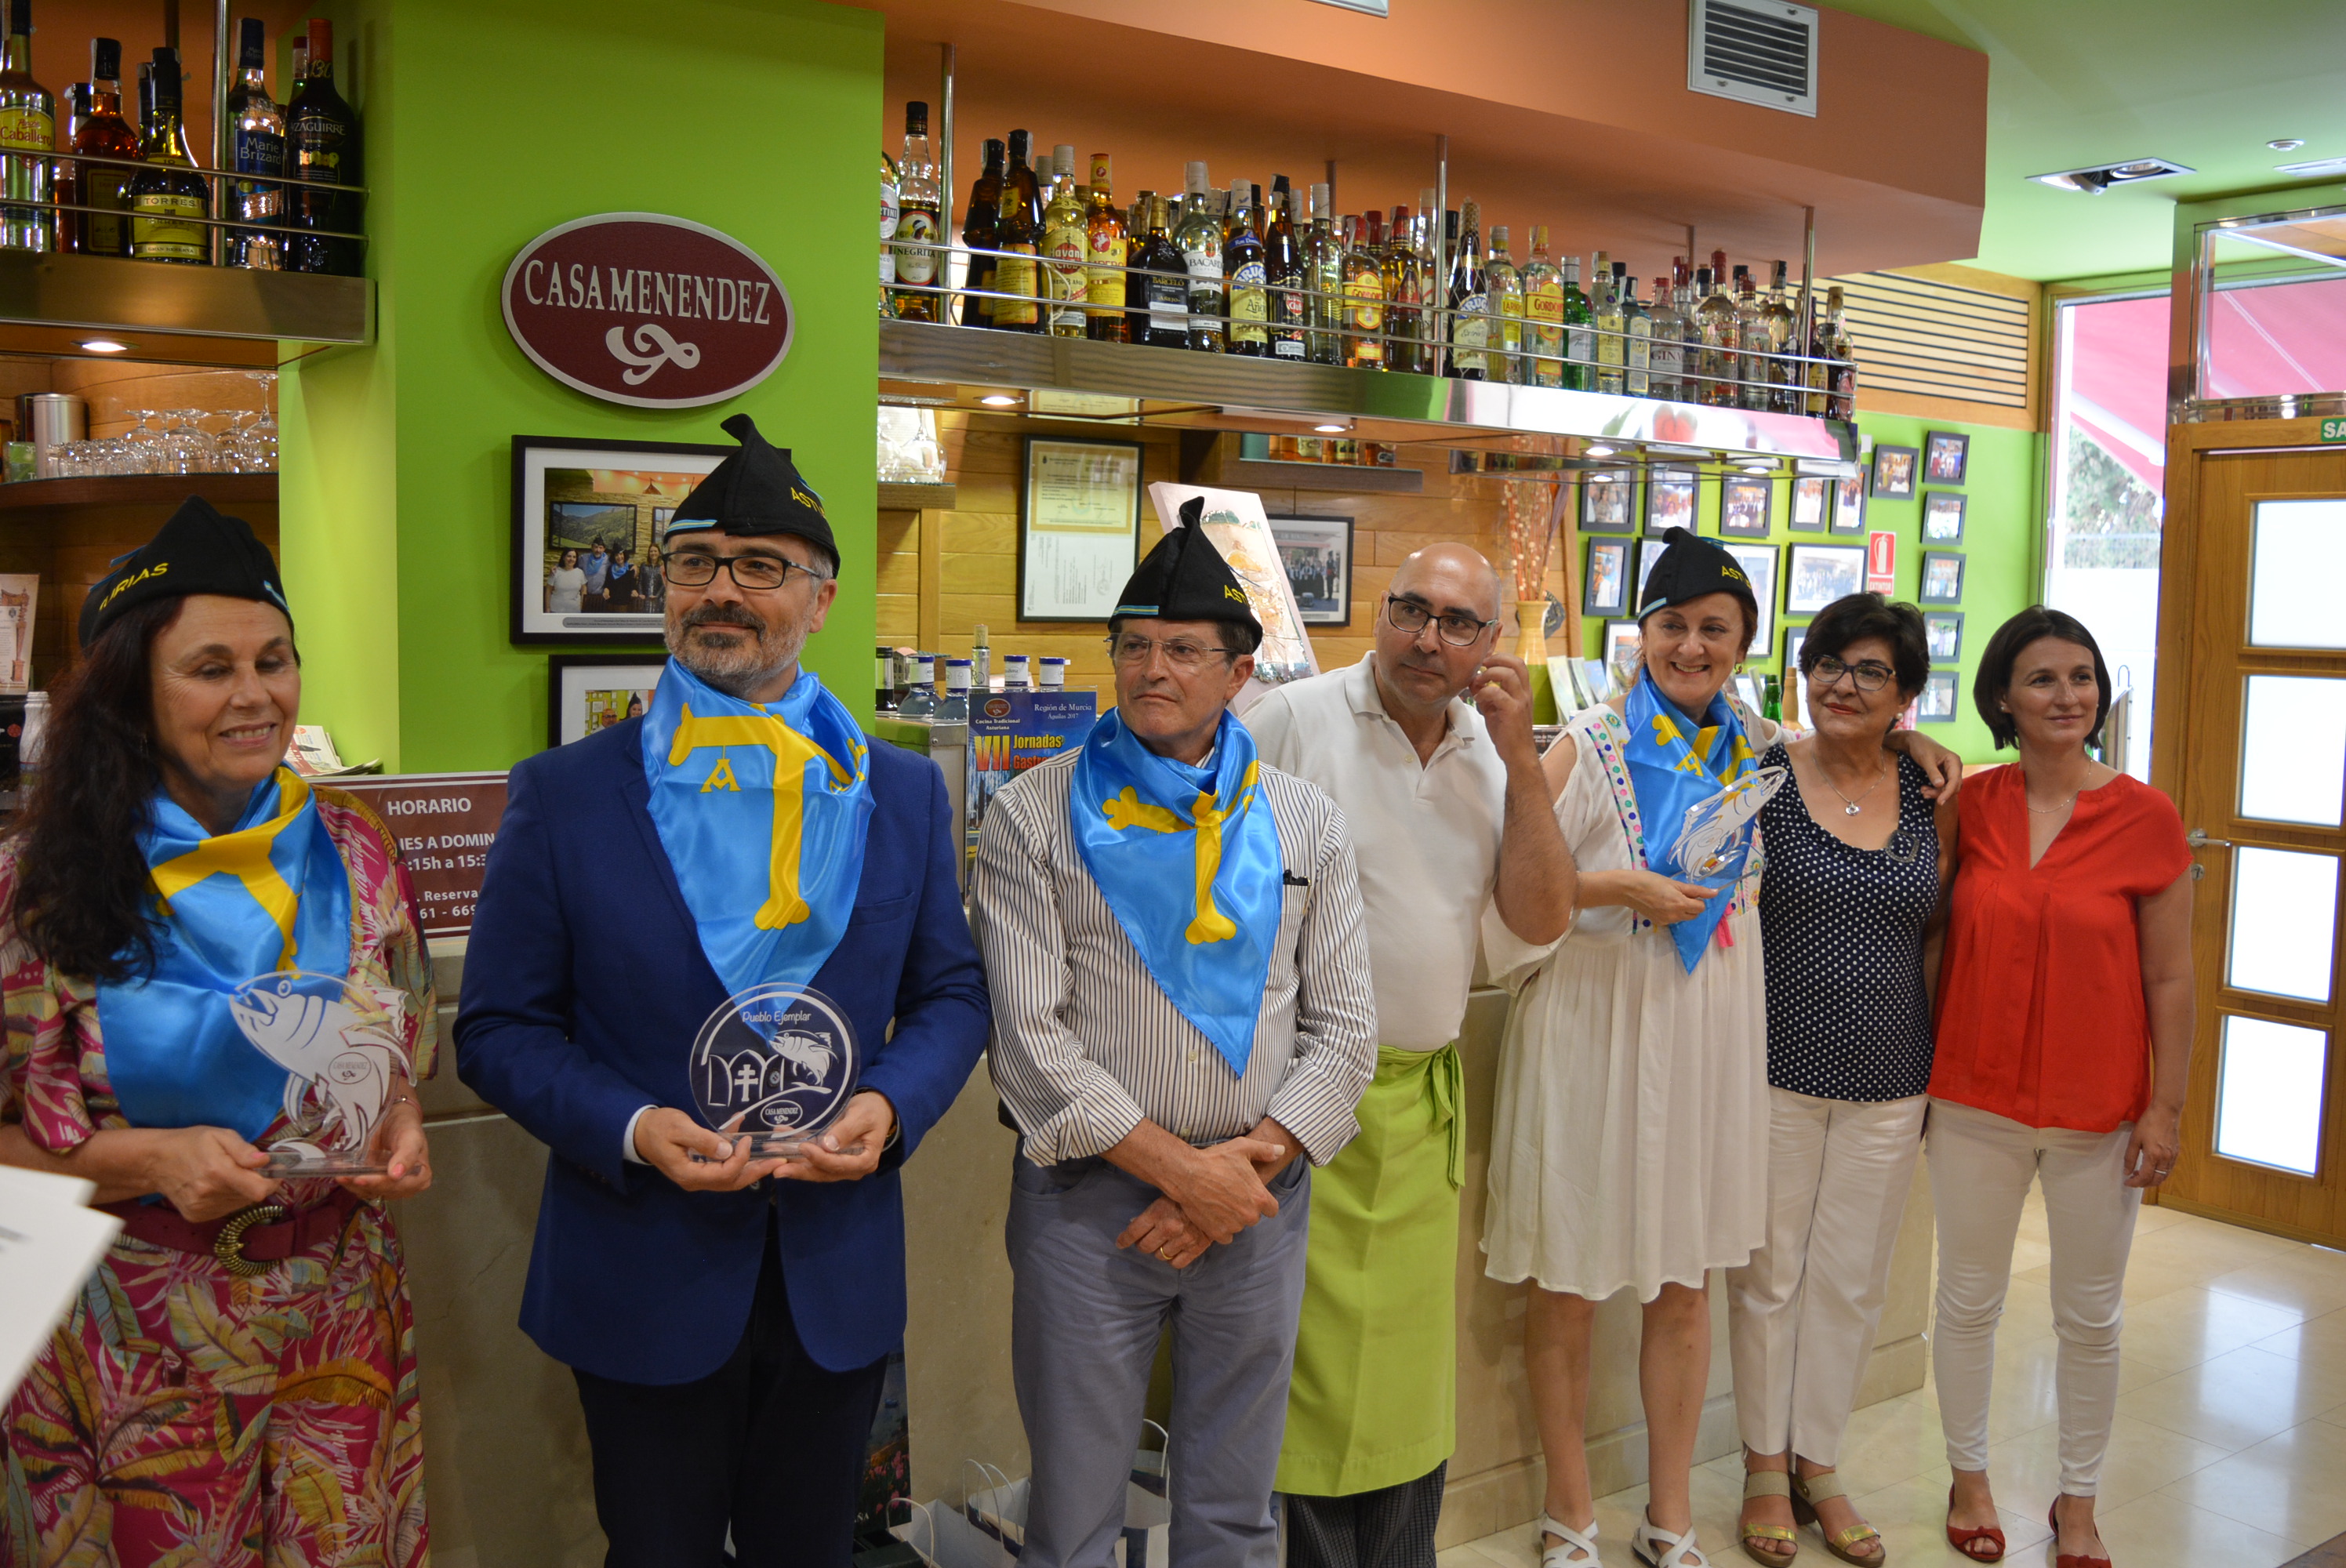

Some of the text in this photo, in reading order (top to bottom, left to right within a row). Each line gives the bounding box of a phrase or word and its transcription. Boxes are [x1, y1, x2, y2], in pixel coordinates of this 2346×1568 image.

[0, 126, 52, 146] Caballero
[246, 136, 279, 153] Marie
[240, 147, 281, 165] Brizard
[144, 198, 195, 207] TORRES
[897, 248, 936, 259] NEGRITA
[1049, 248, 1084, 259] Havana
[1153, 277, 1185, 287] BARCELÓ
[1289, 301, 1303, 311] Club
[1034, 703, 1058, 713] Región
[1013, 734, 1063, 750] Jornadas
[973, 735, 1011, 771] VII
[387, 797, 472, 816] HORARIO
[427, 836, 439, 849] A
[441, 833, 496, 848] DOMIN
[408, 854, 486, 872] :15h a 15:3
[424, 890, 478, 902] Reserva
[452, 904, 475, 917] 669
[742, 1010, 812, 1025] Pueblo Ejemplar
